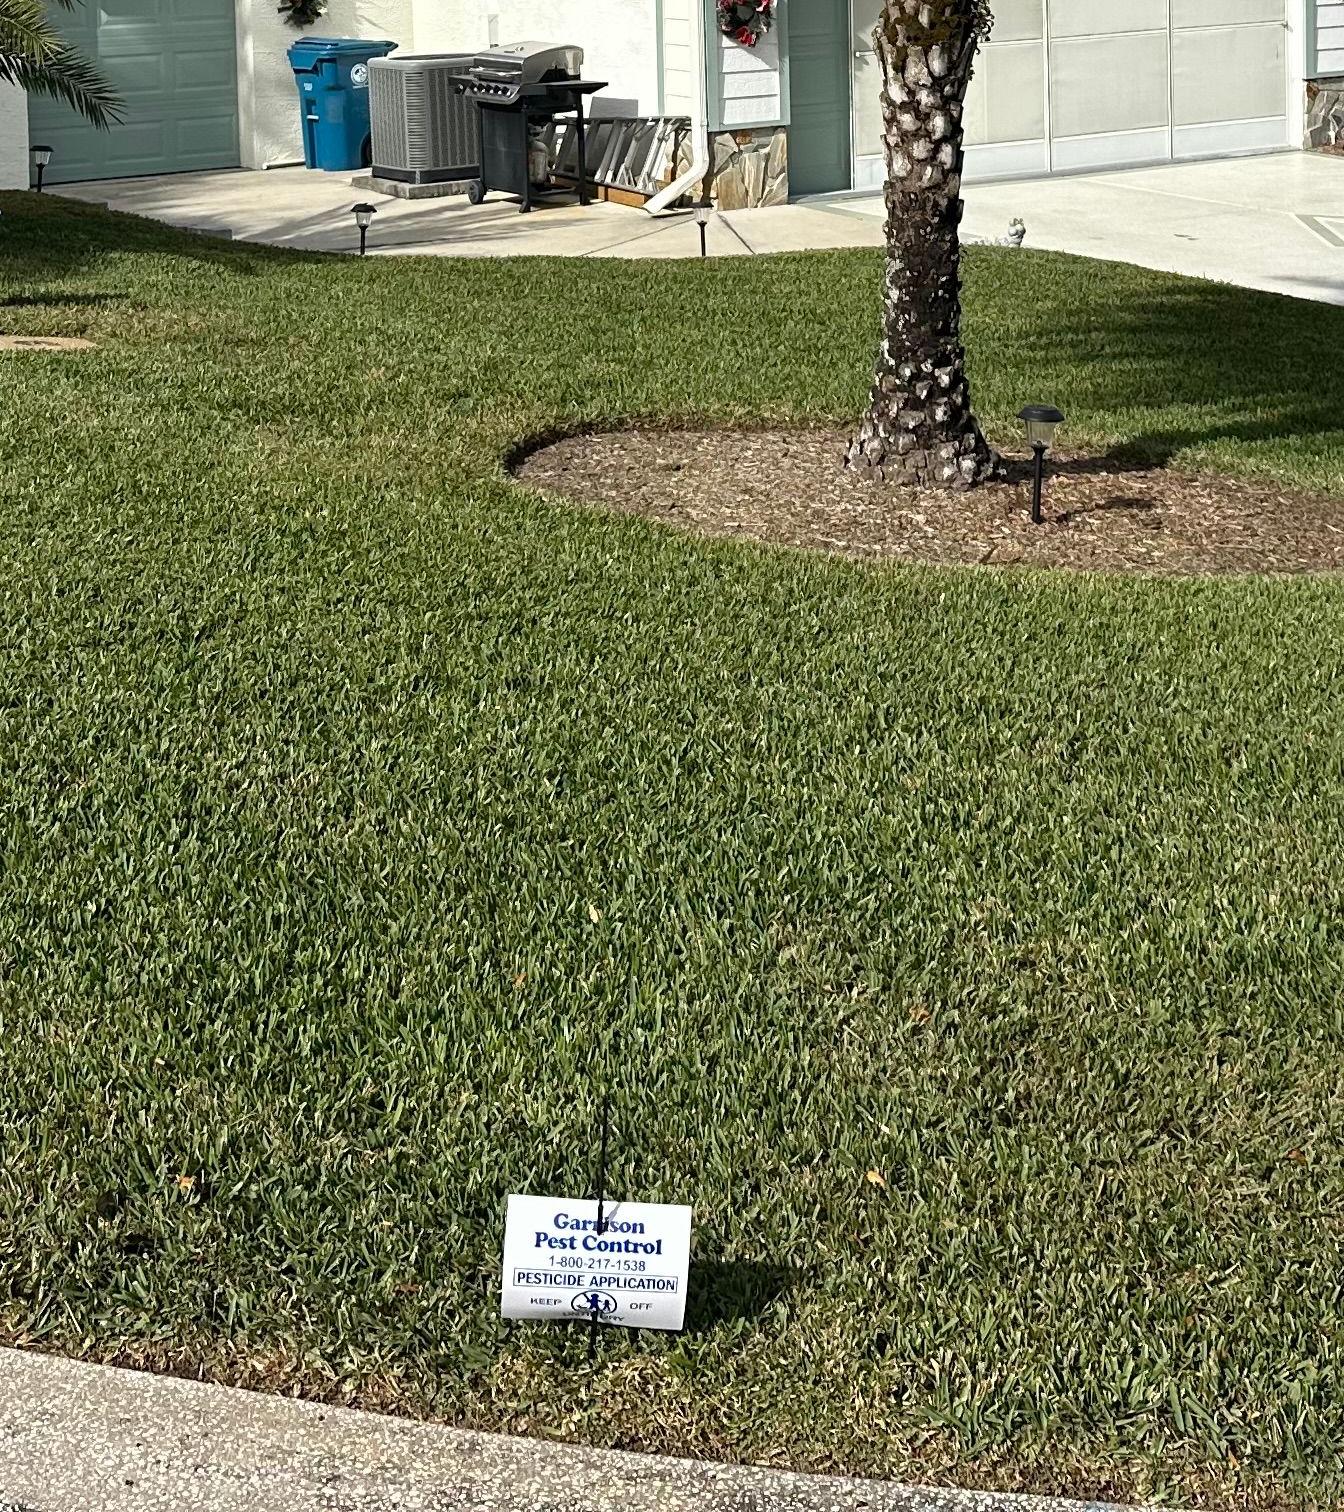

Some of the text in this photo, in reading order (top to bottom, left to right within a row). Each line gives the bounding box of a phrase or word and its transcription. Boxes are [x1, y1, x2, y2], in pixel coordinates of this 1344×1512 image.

[534, 1231, 663, 1255] Pest Control
[548, 1255, 647, 1271] 1-800-217-1538
[517, 1272, 676, 1291] PESTICIDE APPLICATION
[530, 1297, 654, 1310] KEEP OFF
